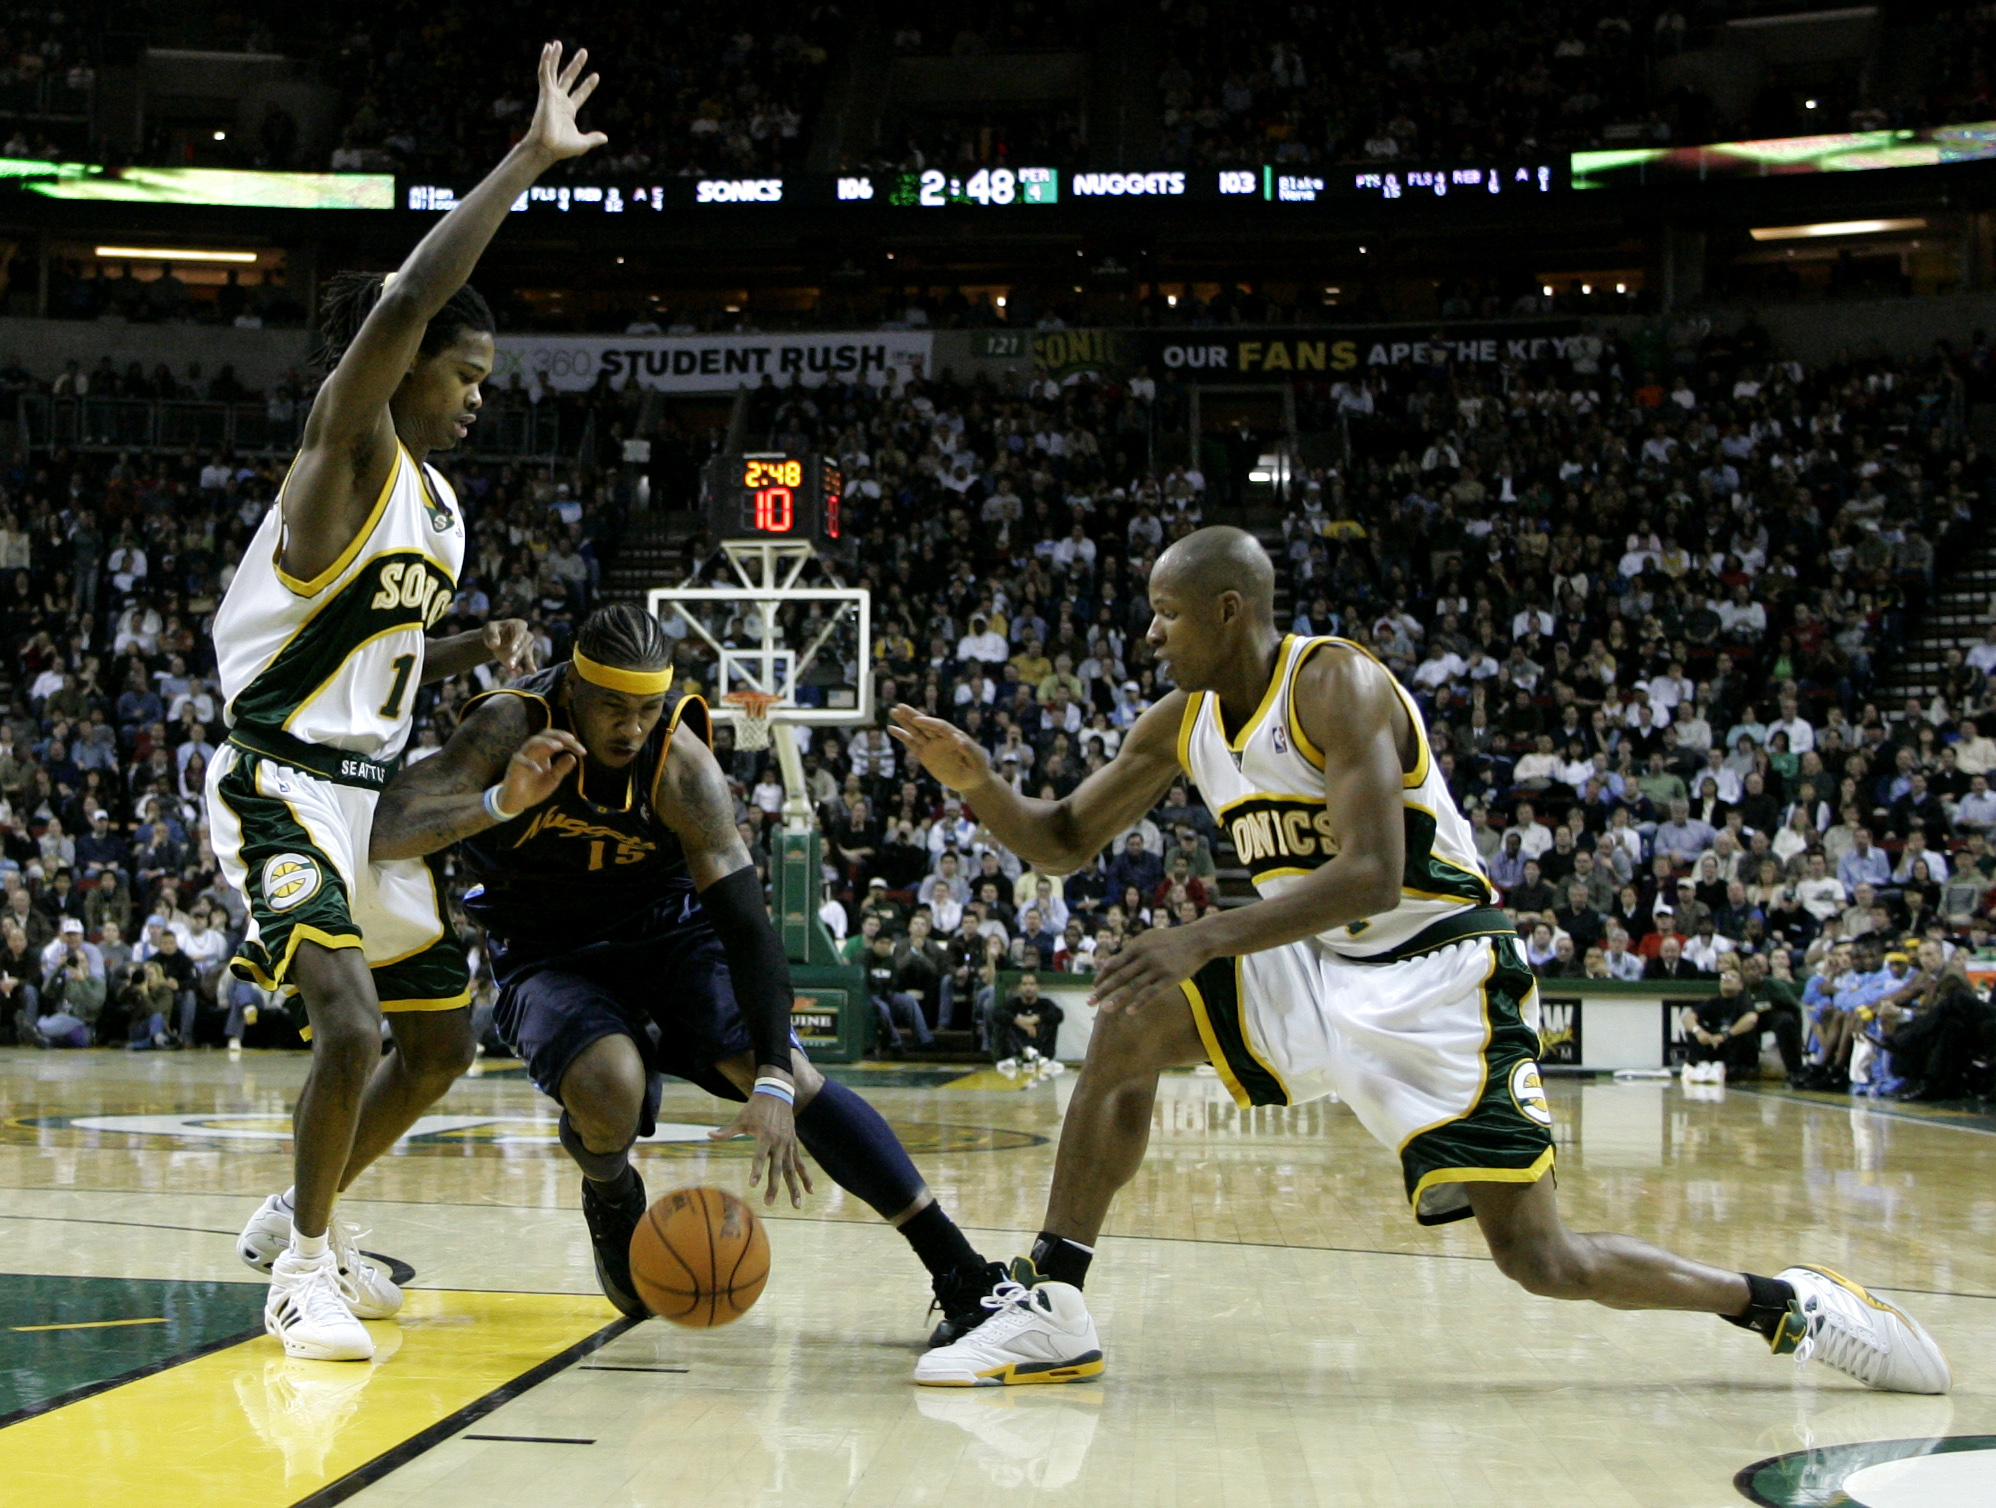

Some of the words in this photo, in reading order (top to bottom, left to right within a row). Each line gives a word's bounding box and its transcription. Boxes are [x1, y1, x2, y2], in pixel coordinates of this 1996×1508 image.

[698, 180, 782, 201] SONICS
[838, 178, 873, 199] 106
[920, 169, 1015, 206] 2:48
[1019, 168, 1049, 183] PER
[1073, 172, 1185, 195] NUGGETS
[1219, 172, 1255, 193] 103
[1356, 174, 1381, 188] PTS
[1408, 172, 1432, 186] FLS
[1515, 168, 1528, 181] A
[634, 188, 646, 200] A
[1029, 184, 1041, 201] 4
[601, 348, 769, 377] STUDENT
[780, 344, 886, 373] RUSH
[1163, 345, 1228, 369] OUR
[1237, 340, 1358, 372] FANS
[744, 460, 802, 488] 2:48
[755, 487, 794, 532] 10
[379, 653, 417, 721] 1
[1231, 810, 1342, 865] ONICS
[587, 839, 647, 871] 15
